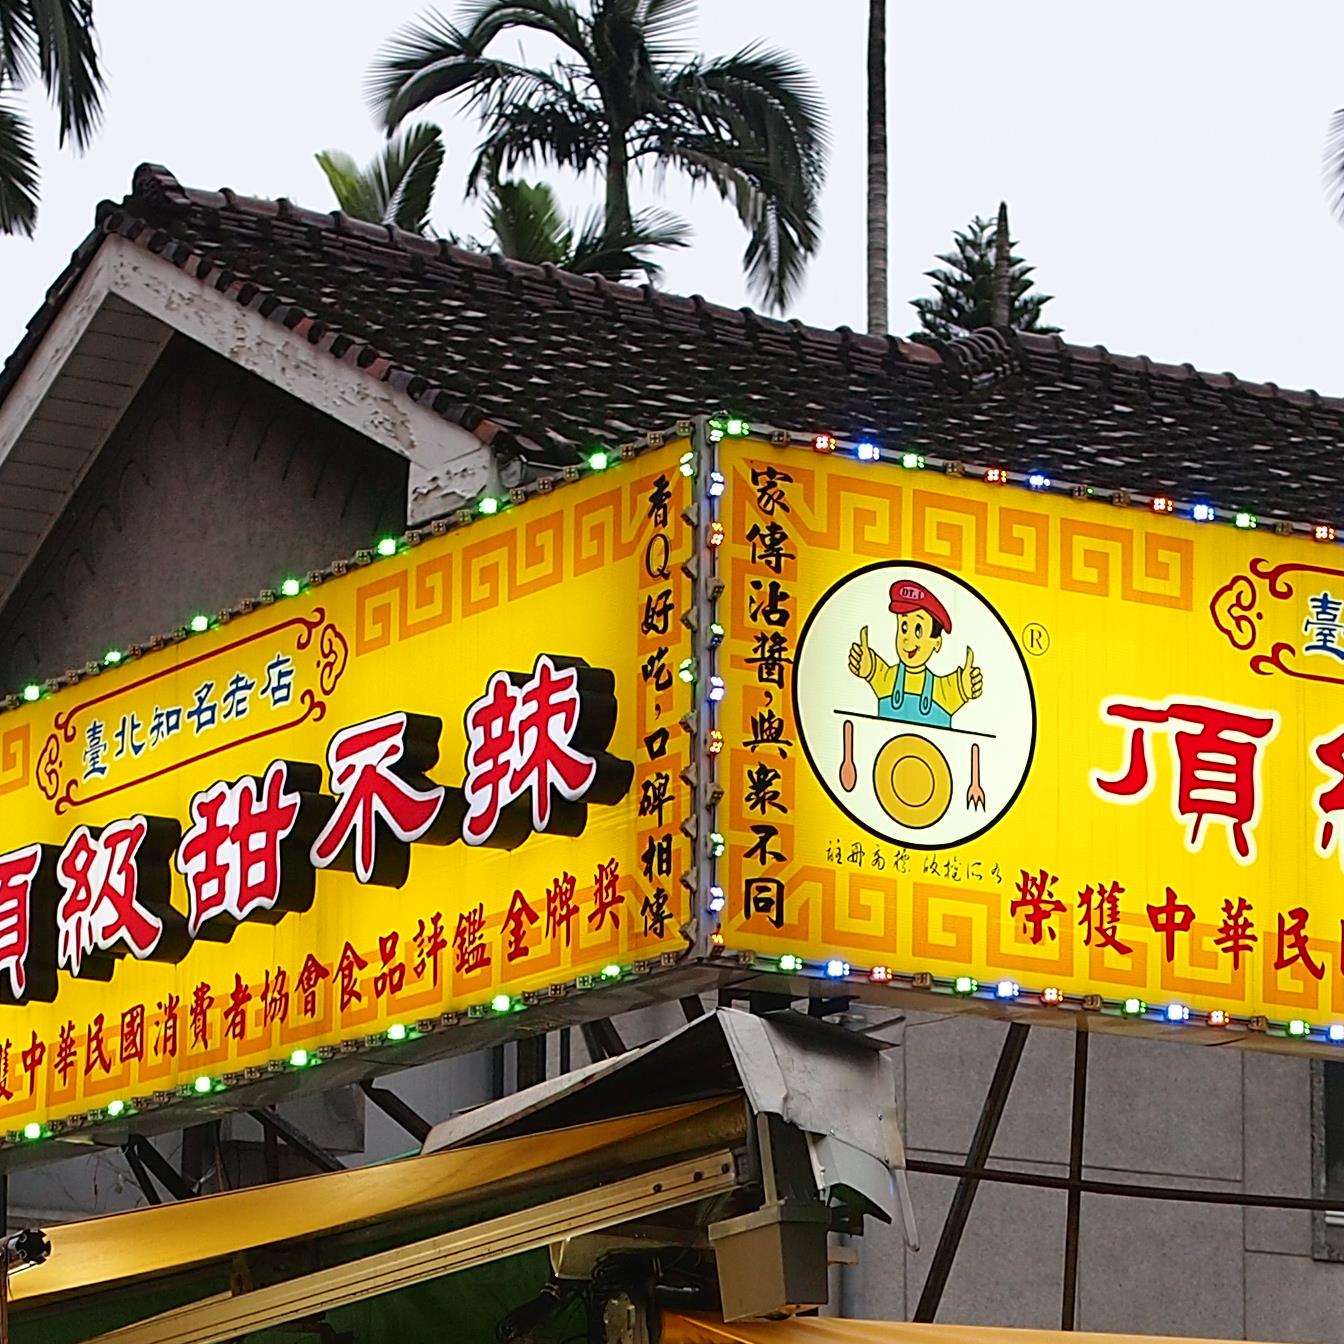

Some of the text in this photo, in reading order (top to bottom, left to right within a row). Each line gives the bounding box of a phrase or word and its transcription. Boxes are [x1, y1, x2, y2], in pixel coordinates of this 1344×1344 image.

[82, 652, 295, 780] 臺北知名老店
